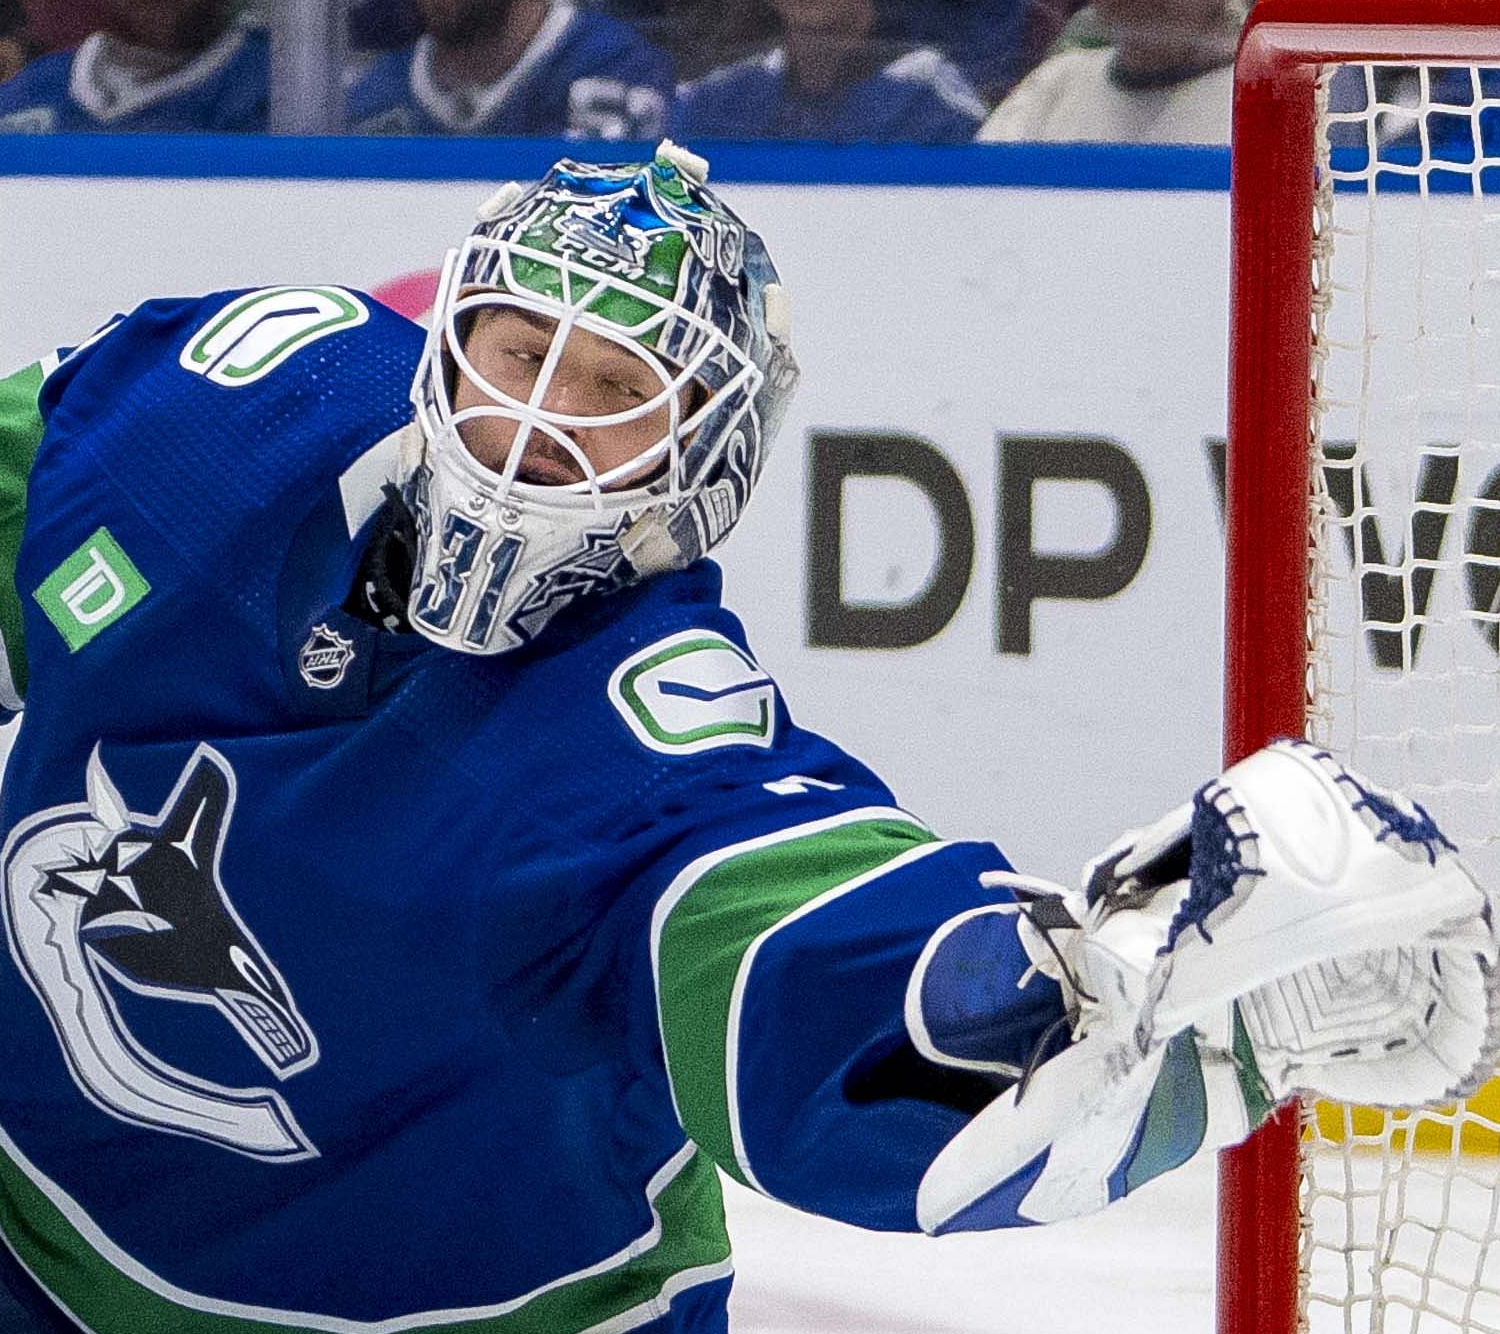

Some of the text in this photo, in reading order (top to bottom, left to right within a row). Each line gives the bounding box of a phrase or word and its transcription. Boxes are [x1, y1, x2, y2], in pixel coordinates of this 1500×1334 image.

[59, 546, 127, 626] TD
[412, 508, 527, 650] 31
[803, 427, 1155, 659] DP
